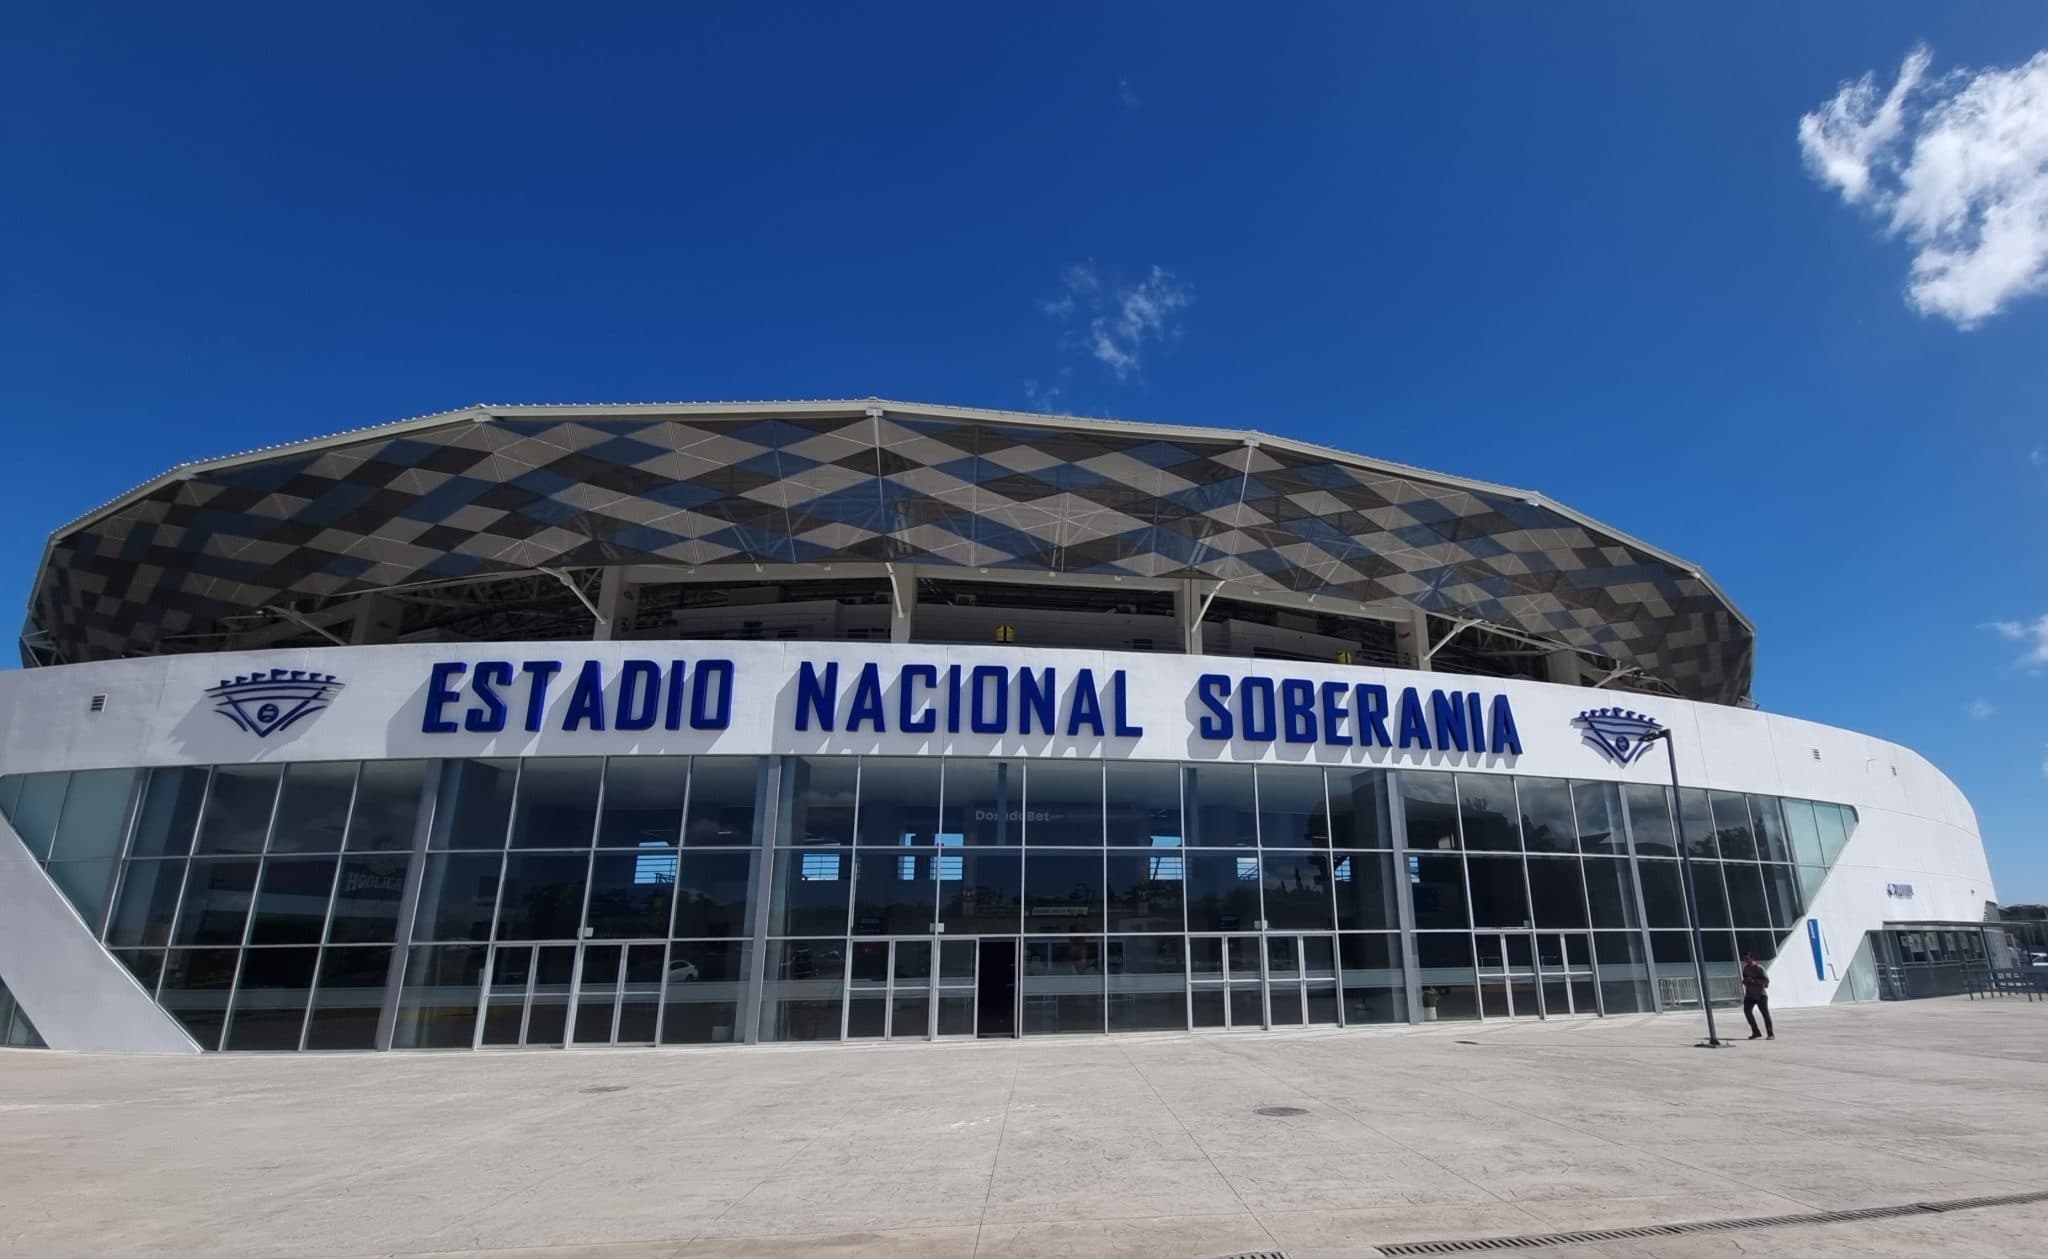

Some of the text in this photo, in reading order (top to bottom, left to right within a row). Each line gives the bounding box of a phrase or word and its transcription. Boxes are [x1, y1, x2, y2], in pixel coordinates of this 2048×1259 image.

[421, 659, 1523, 755] ESTADIO NACIONAL SOBERANIA
[975, 809, 1050, 822] DordBet
